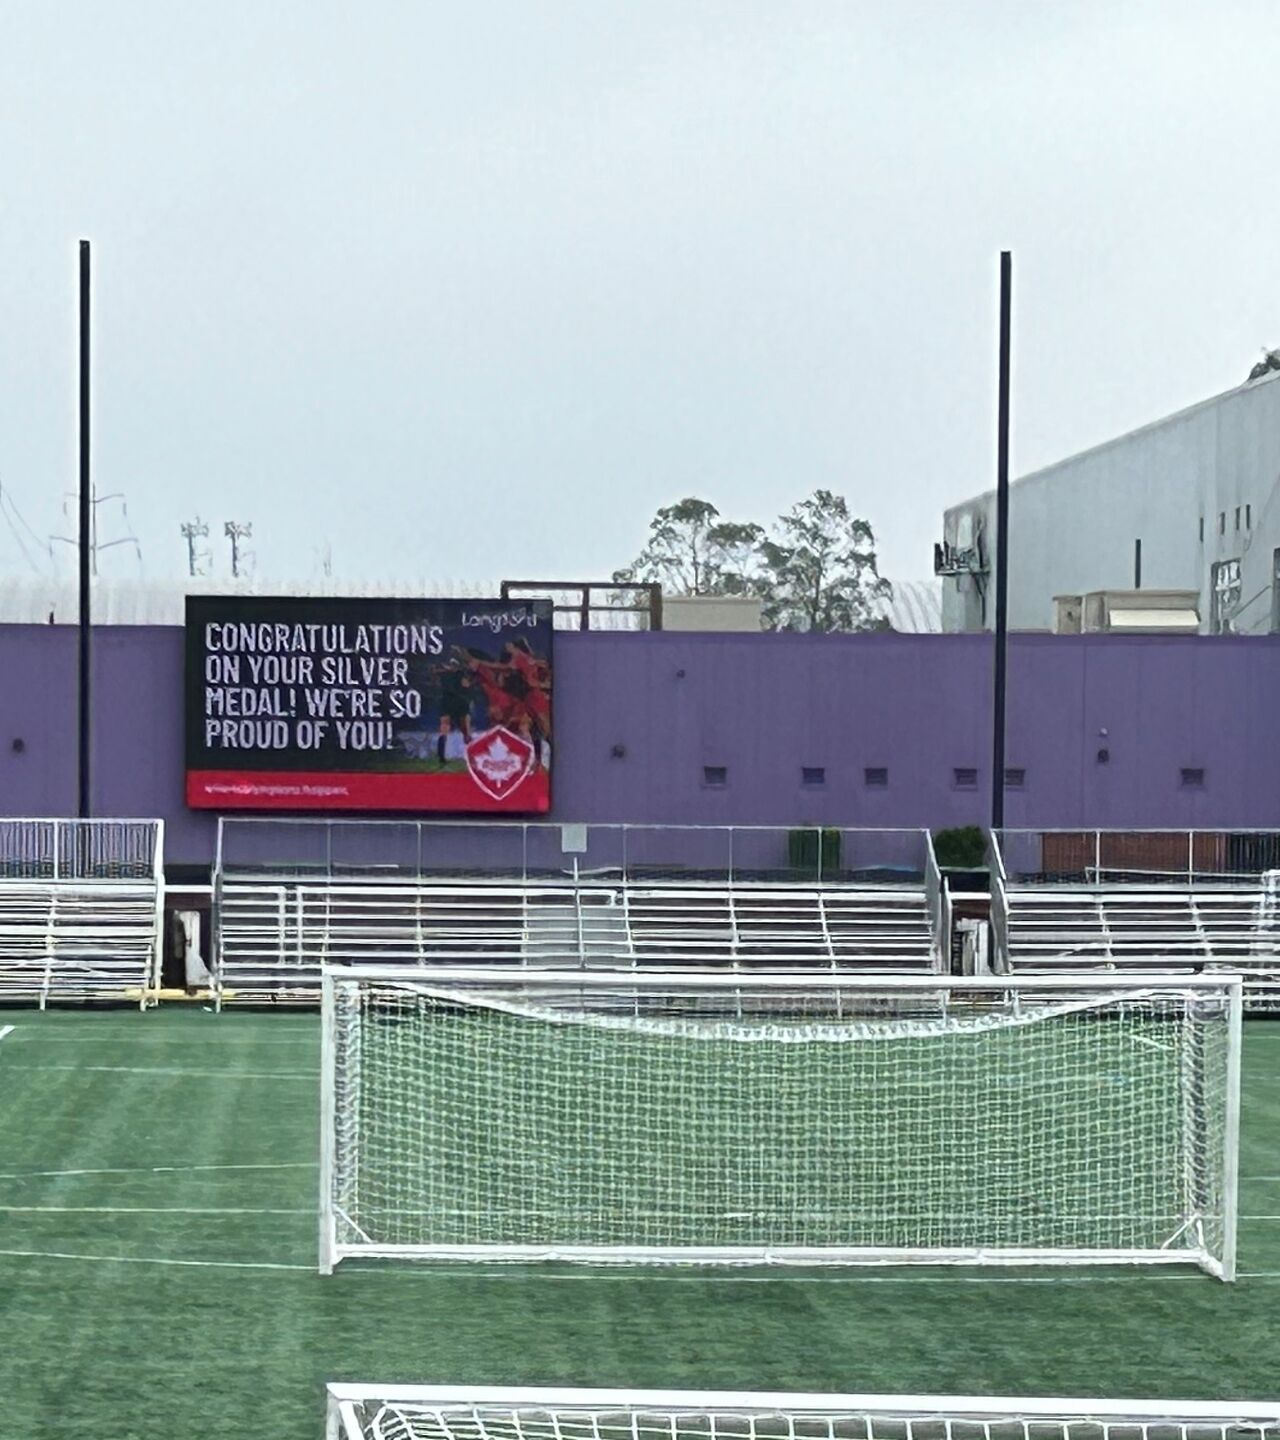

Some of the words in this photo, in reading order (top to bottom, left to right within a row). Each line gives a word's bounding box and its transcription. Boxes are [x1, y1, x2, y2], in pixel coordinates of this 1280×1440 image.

[204, 622, 444, 655] CONGRATULATIONS
[205, 655, 240, 686] ON
[247, 656, 314, 686] YOUR
[321, 656, 409, 687] SILVER
[204, 686, 296, 718] MEDAL!
[304, 688, 382, 718] WE'RE
[388, 688, 423, 718] SO
[204, 718, 290, 750] PROUD
[295, 720, 333, 750] OF
[336, 721, 394, 751] YOU!
